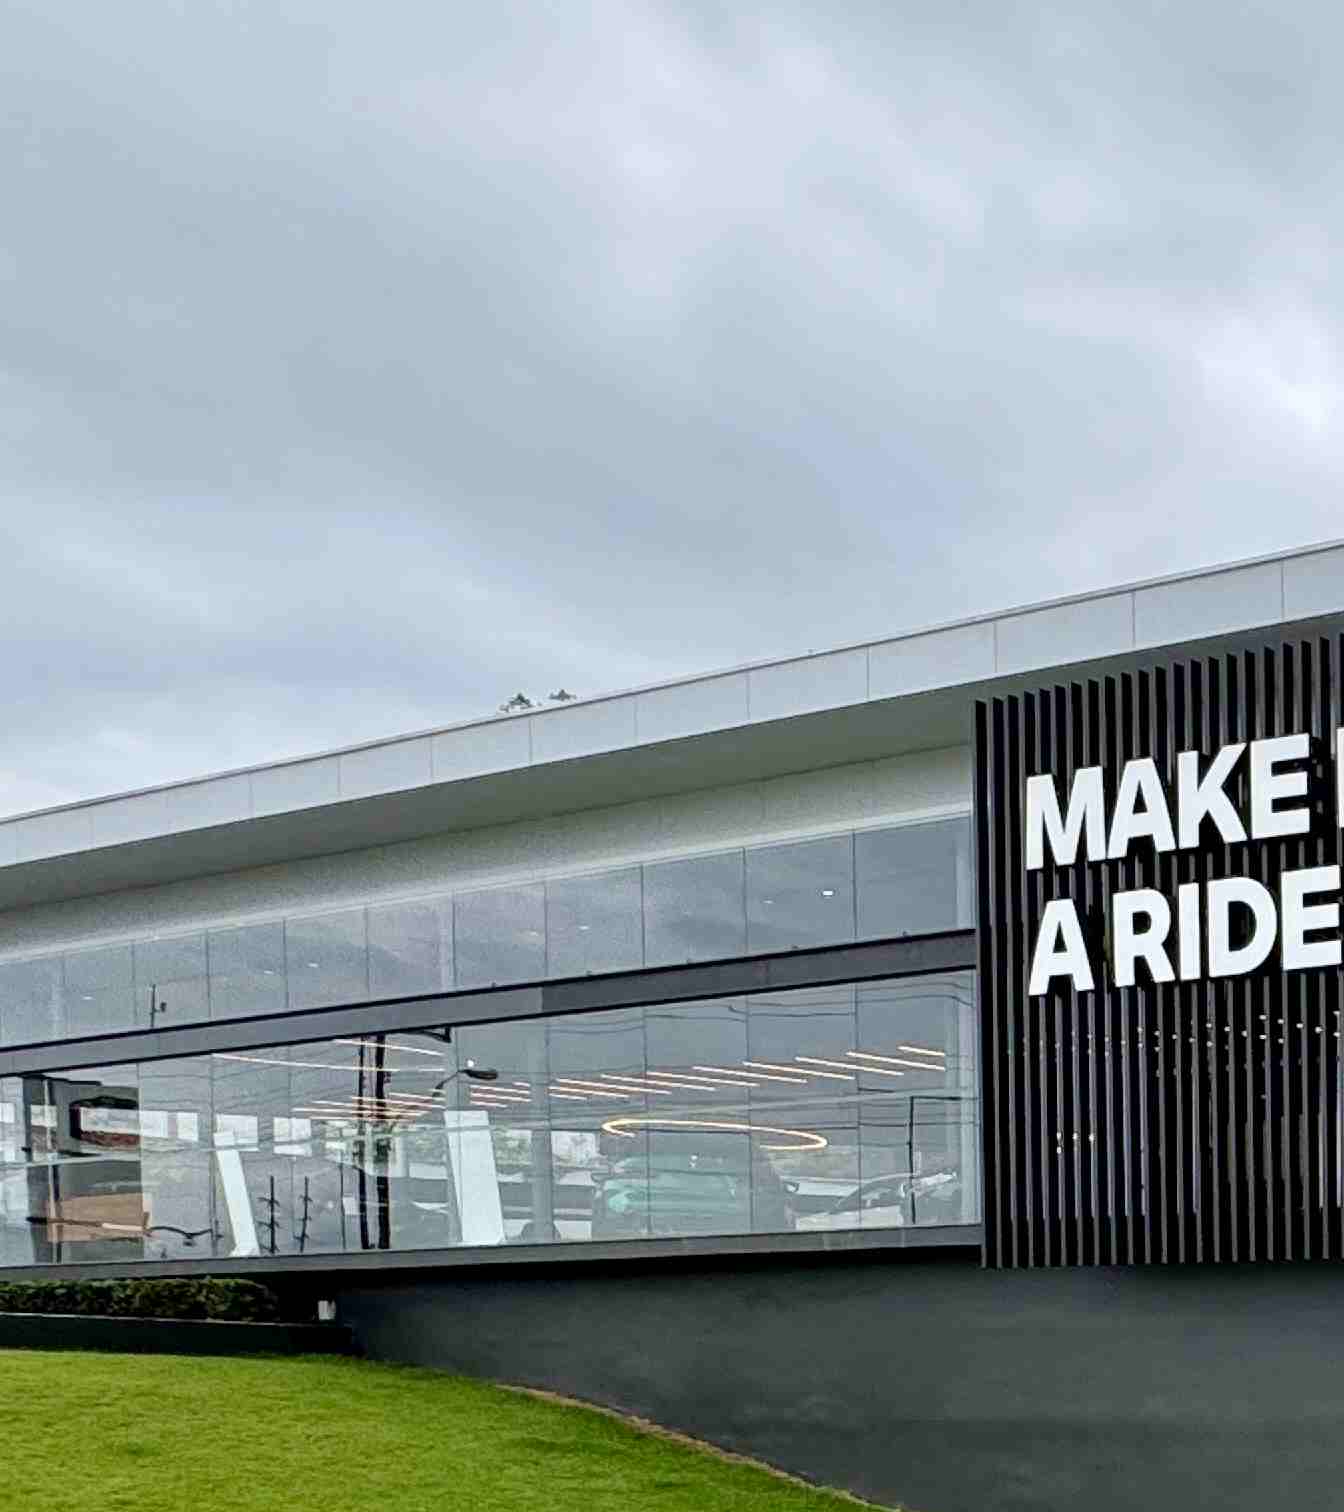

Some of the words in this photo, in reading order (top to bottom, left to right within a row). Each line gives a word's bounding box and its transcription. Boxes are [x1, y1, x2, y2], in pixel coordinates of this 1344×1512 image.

[1026, 733, 1311, 870] MAKE
[1028, 898, 1095, 996] A
[1112, 864, 1342, 988] RIDE
